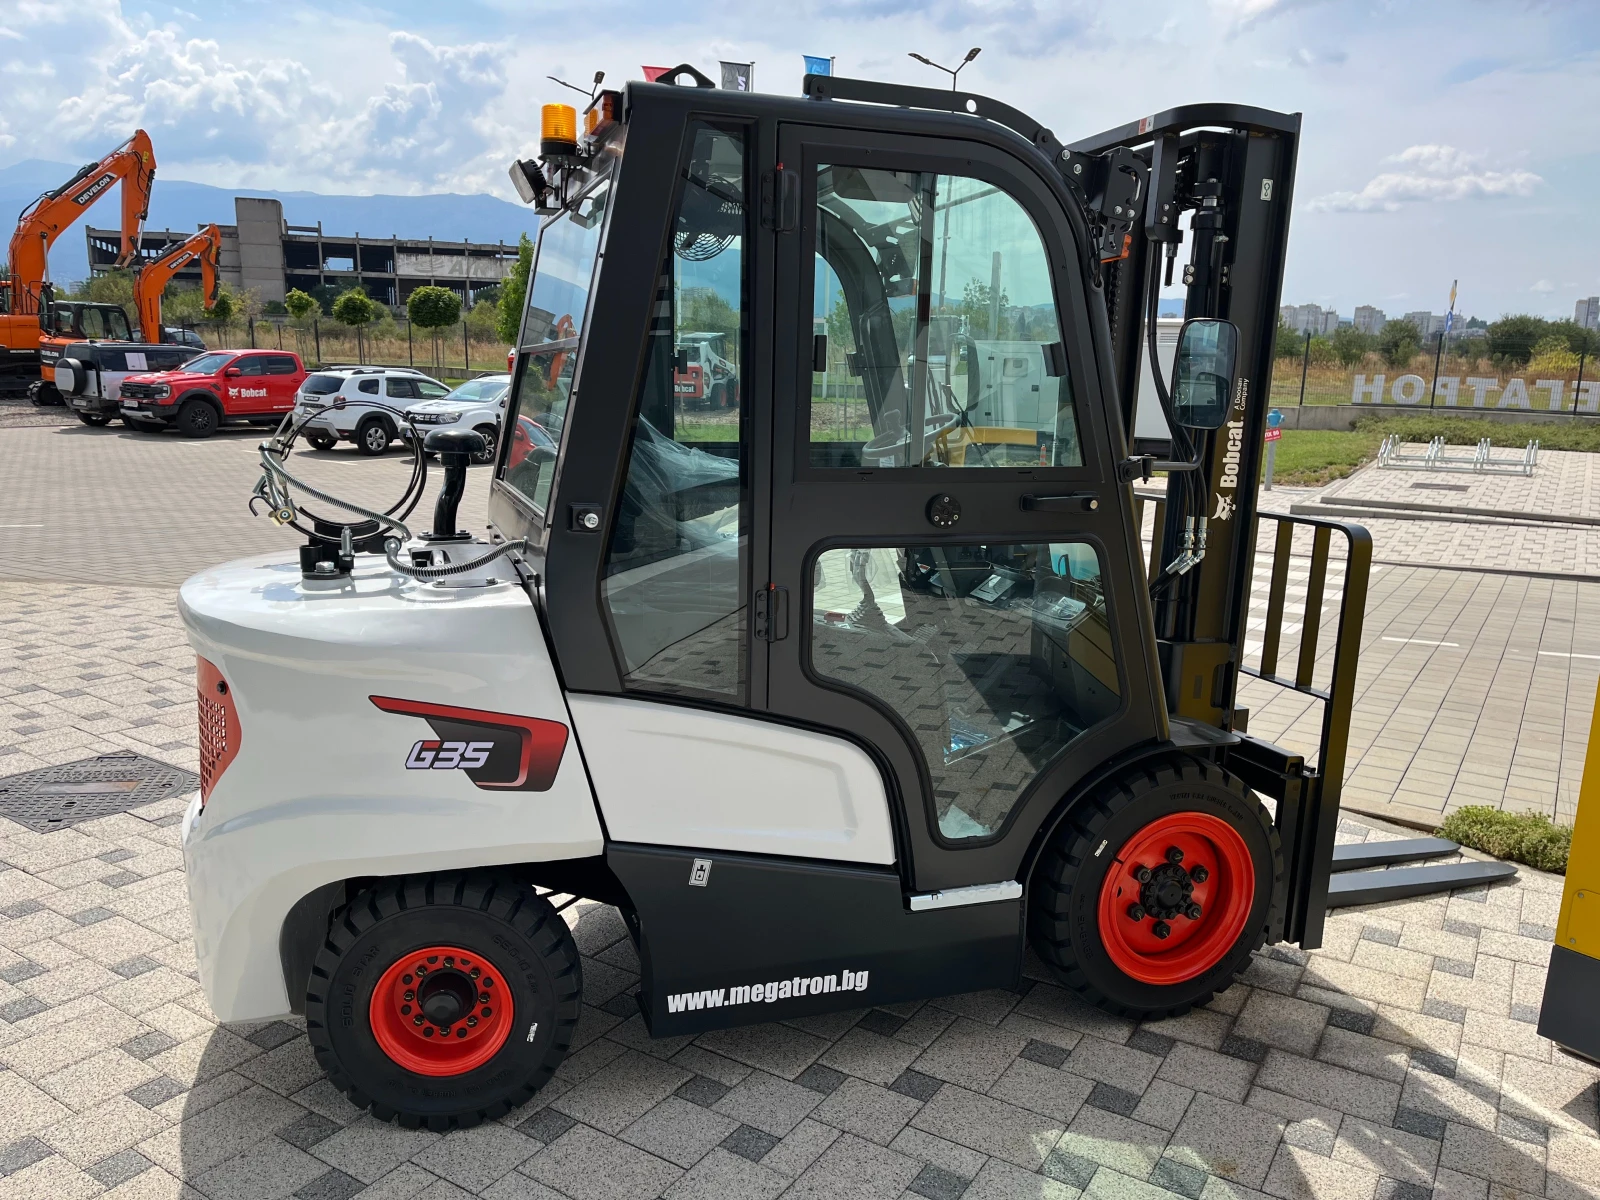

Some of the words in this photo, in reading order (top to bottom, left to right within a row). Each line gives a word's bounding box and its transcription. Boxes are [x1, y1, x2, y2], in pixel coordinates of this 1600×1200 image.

[77, 176, 111, 205] DEVELON
[169, 253, 190, 269] DEVELON
[241, 388, 266, 398] Bobcat
[1234, 378, 1242, 406] Doosan
[1240, 378, 1249, 410] Company
[1220, 420, 1244, 488] Bobcat
[405, 740, 494, 769] G35
[340, 984, 356, 1028] SOLID
[353, 945, 380, 977] STAR
[667, 969, 869, 1013] www.megatron.bg
